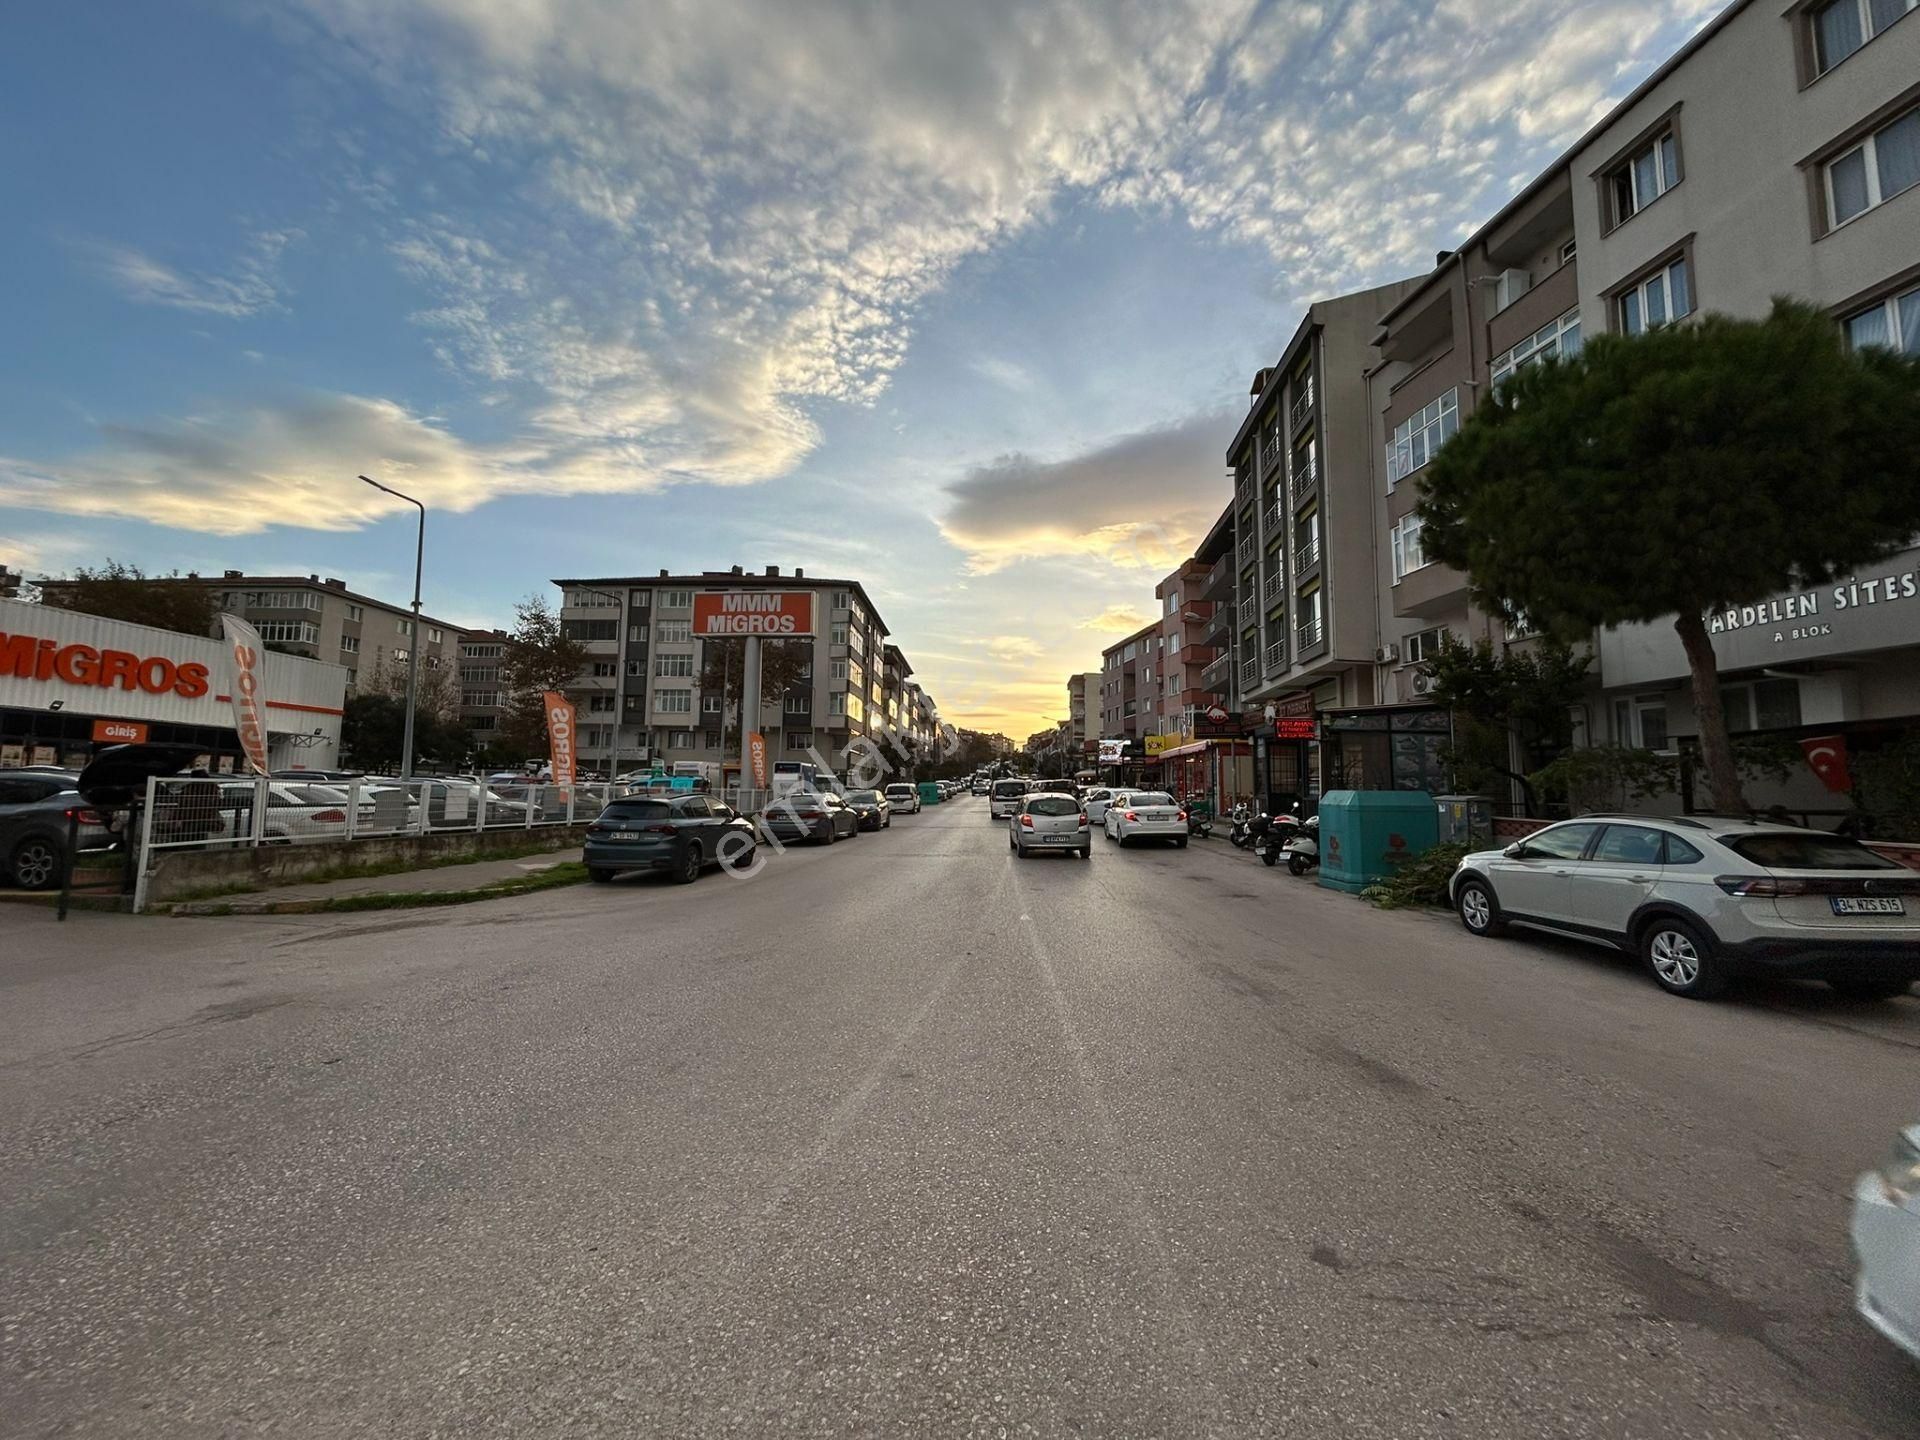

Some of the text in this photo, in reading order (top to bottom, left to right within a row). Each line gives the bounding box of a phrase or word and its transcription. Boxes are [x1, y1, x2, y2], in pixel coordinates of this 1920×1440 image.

[722, 594, 782, 613] MMM
[1702, 564, 1920, 635] ARDELEN SİTES
[1773, 624, 1832, 643] A BLOK
[1839, 899, 1854, 911] 34
